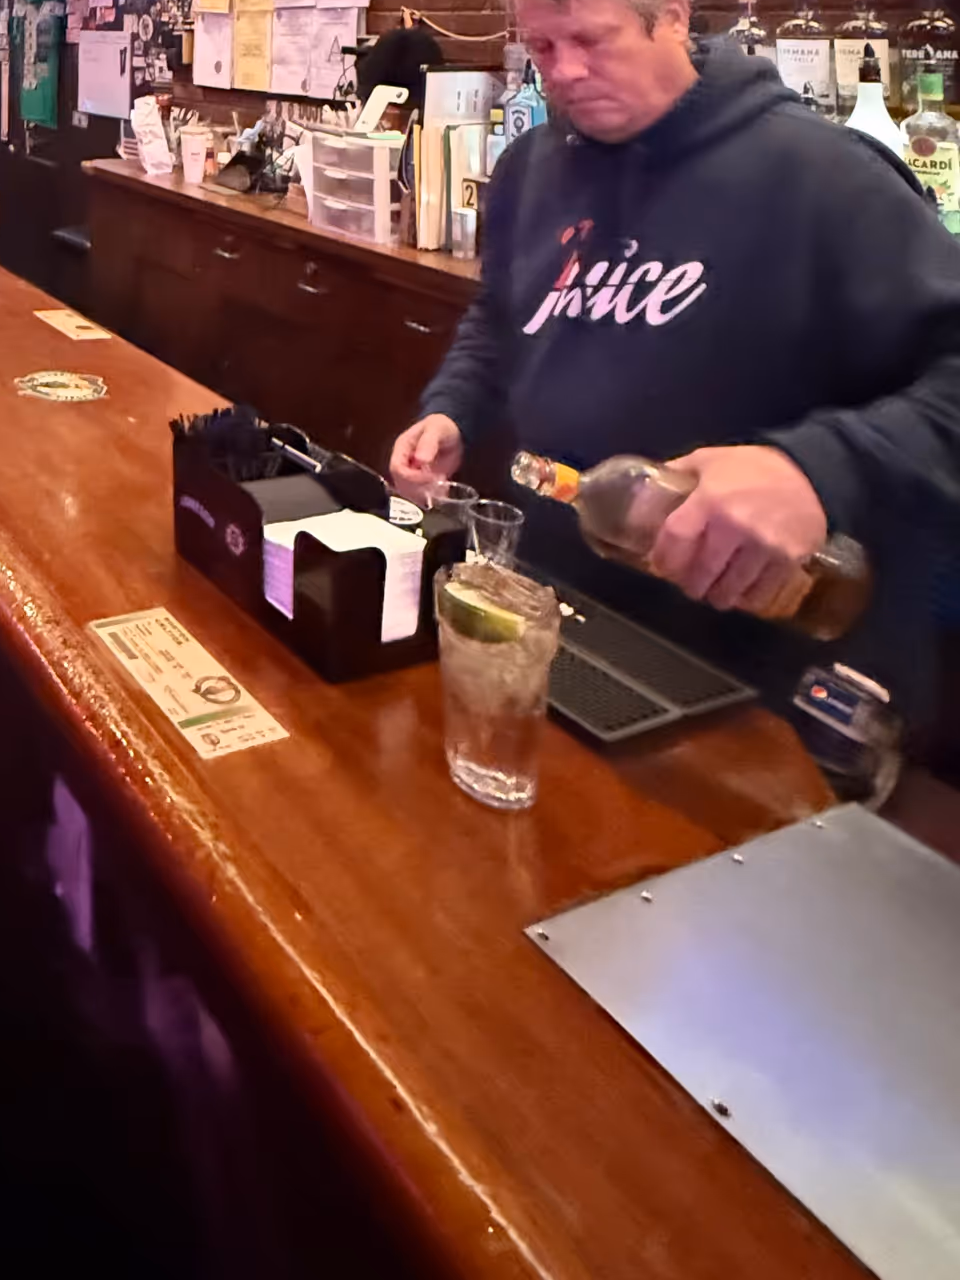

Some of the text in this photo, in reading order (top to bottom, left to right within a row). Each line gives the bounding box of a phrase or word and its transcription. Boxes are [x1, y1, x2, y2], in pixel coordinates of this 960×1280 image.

[902, 49, 959, 59] TEREANA
[908, 157, 953, 171] ACARDÍ
[465, 184, 474, 206] 2
